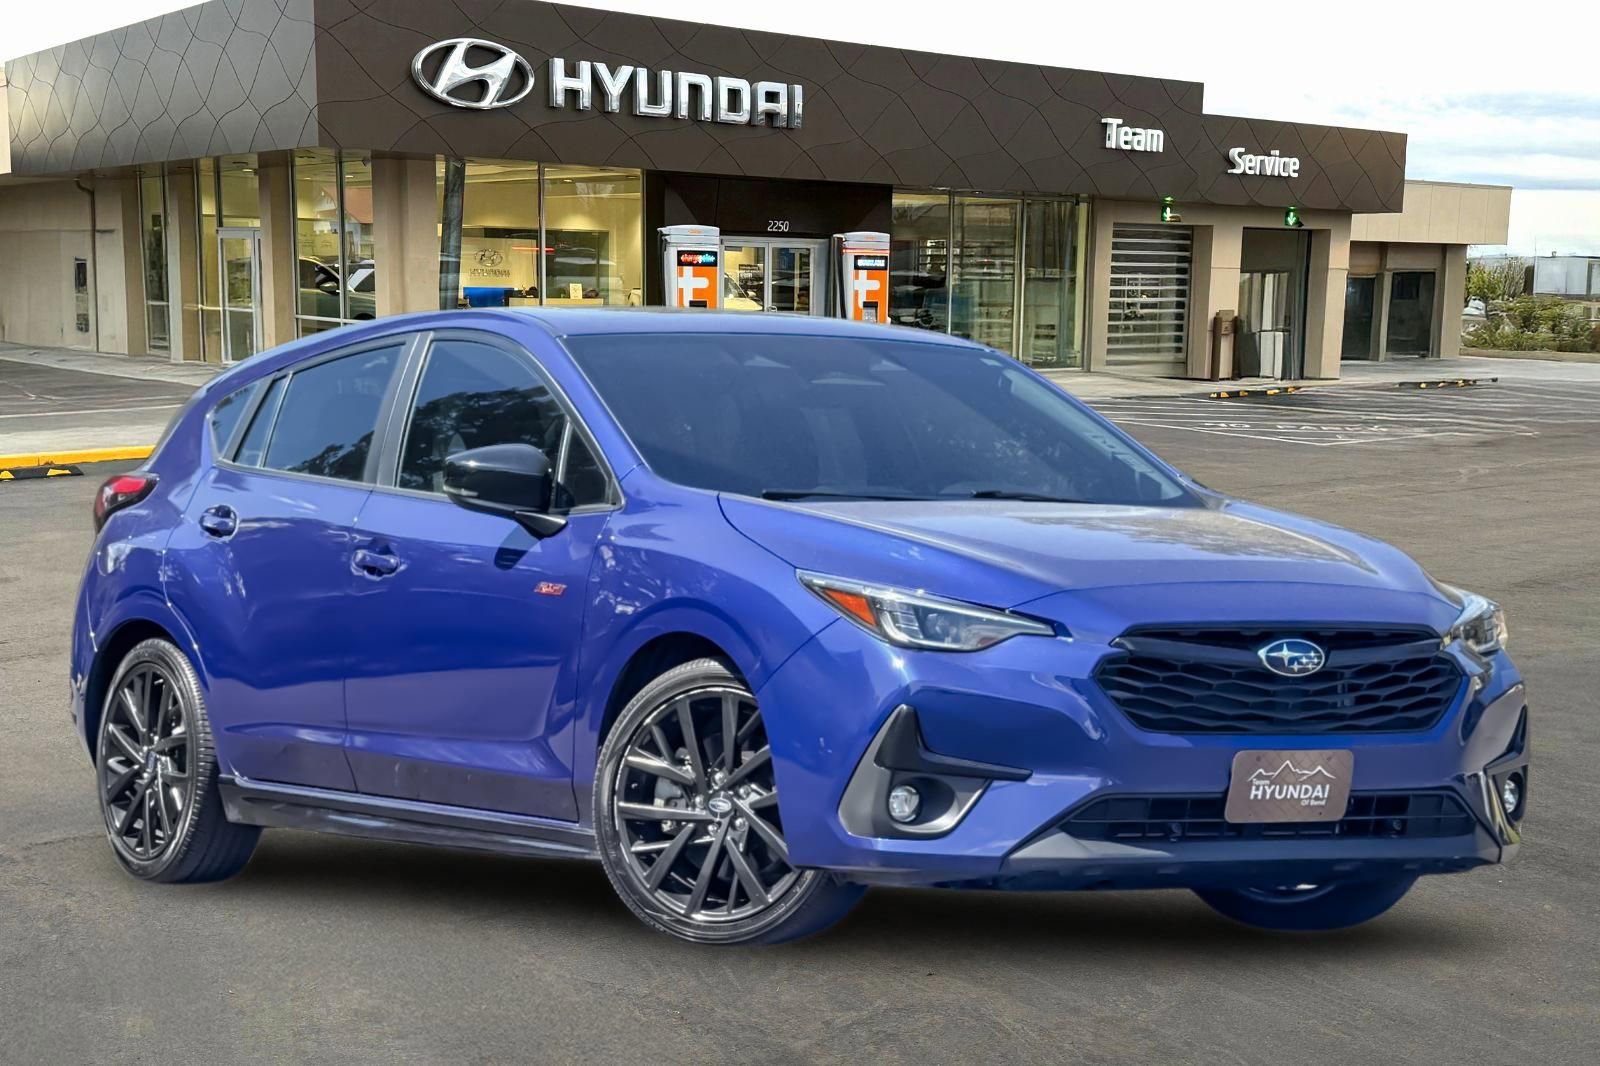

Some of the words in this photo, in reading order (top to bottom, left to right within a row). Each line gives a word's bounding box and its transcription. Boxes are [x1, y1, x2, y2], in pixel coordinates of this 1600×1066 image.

[548, 57, 803, 128] HYUNDAI
[1101, 117, 1164, 152] Team
[1227, 147, 1300, 177] Service
[767, 220, 790, 232] 2250
[1249, 784, 1330, 800] HYUNDAI
